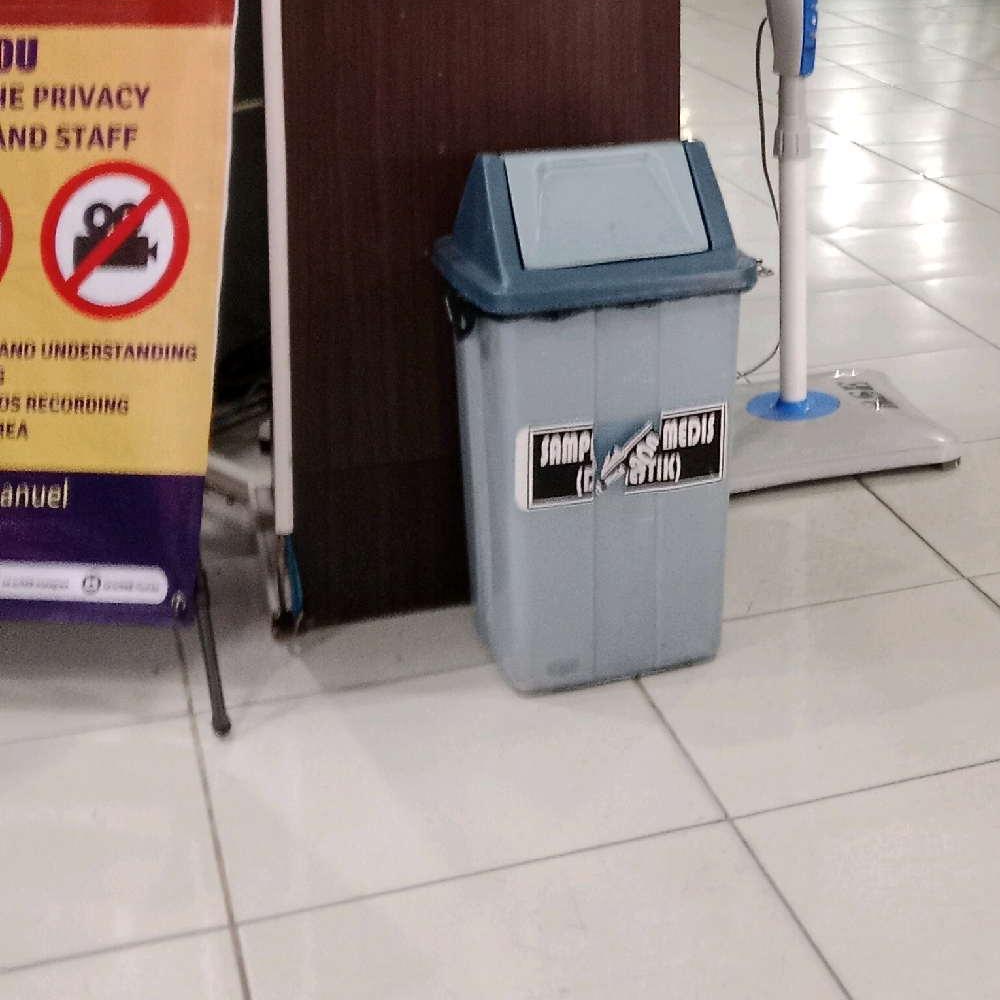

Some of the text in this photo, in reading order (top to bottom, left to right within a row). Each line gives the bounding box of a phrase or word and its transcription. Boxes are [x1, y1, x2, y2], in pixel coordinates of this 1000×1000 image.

[33, 82, 151, 111] PRIVACY
[55, 123, 139, 151] STAFF
[0, 338, 198, 362] AND UNDERSTANDING
[26, 392, 130, 415] RECORDING
[540, 429, 594, 468] SAMP
[662, 411, 716, 451] MEDIS
[0, 476, 69, 509] anuel
